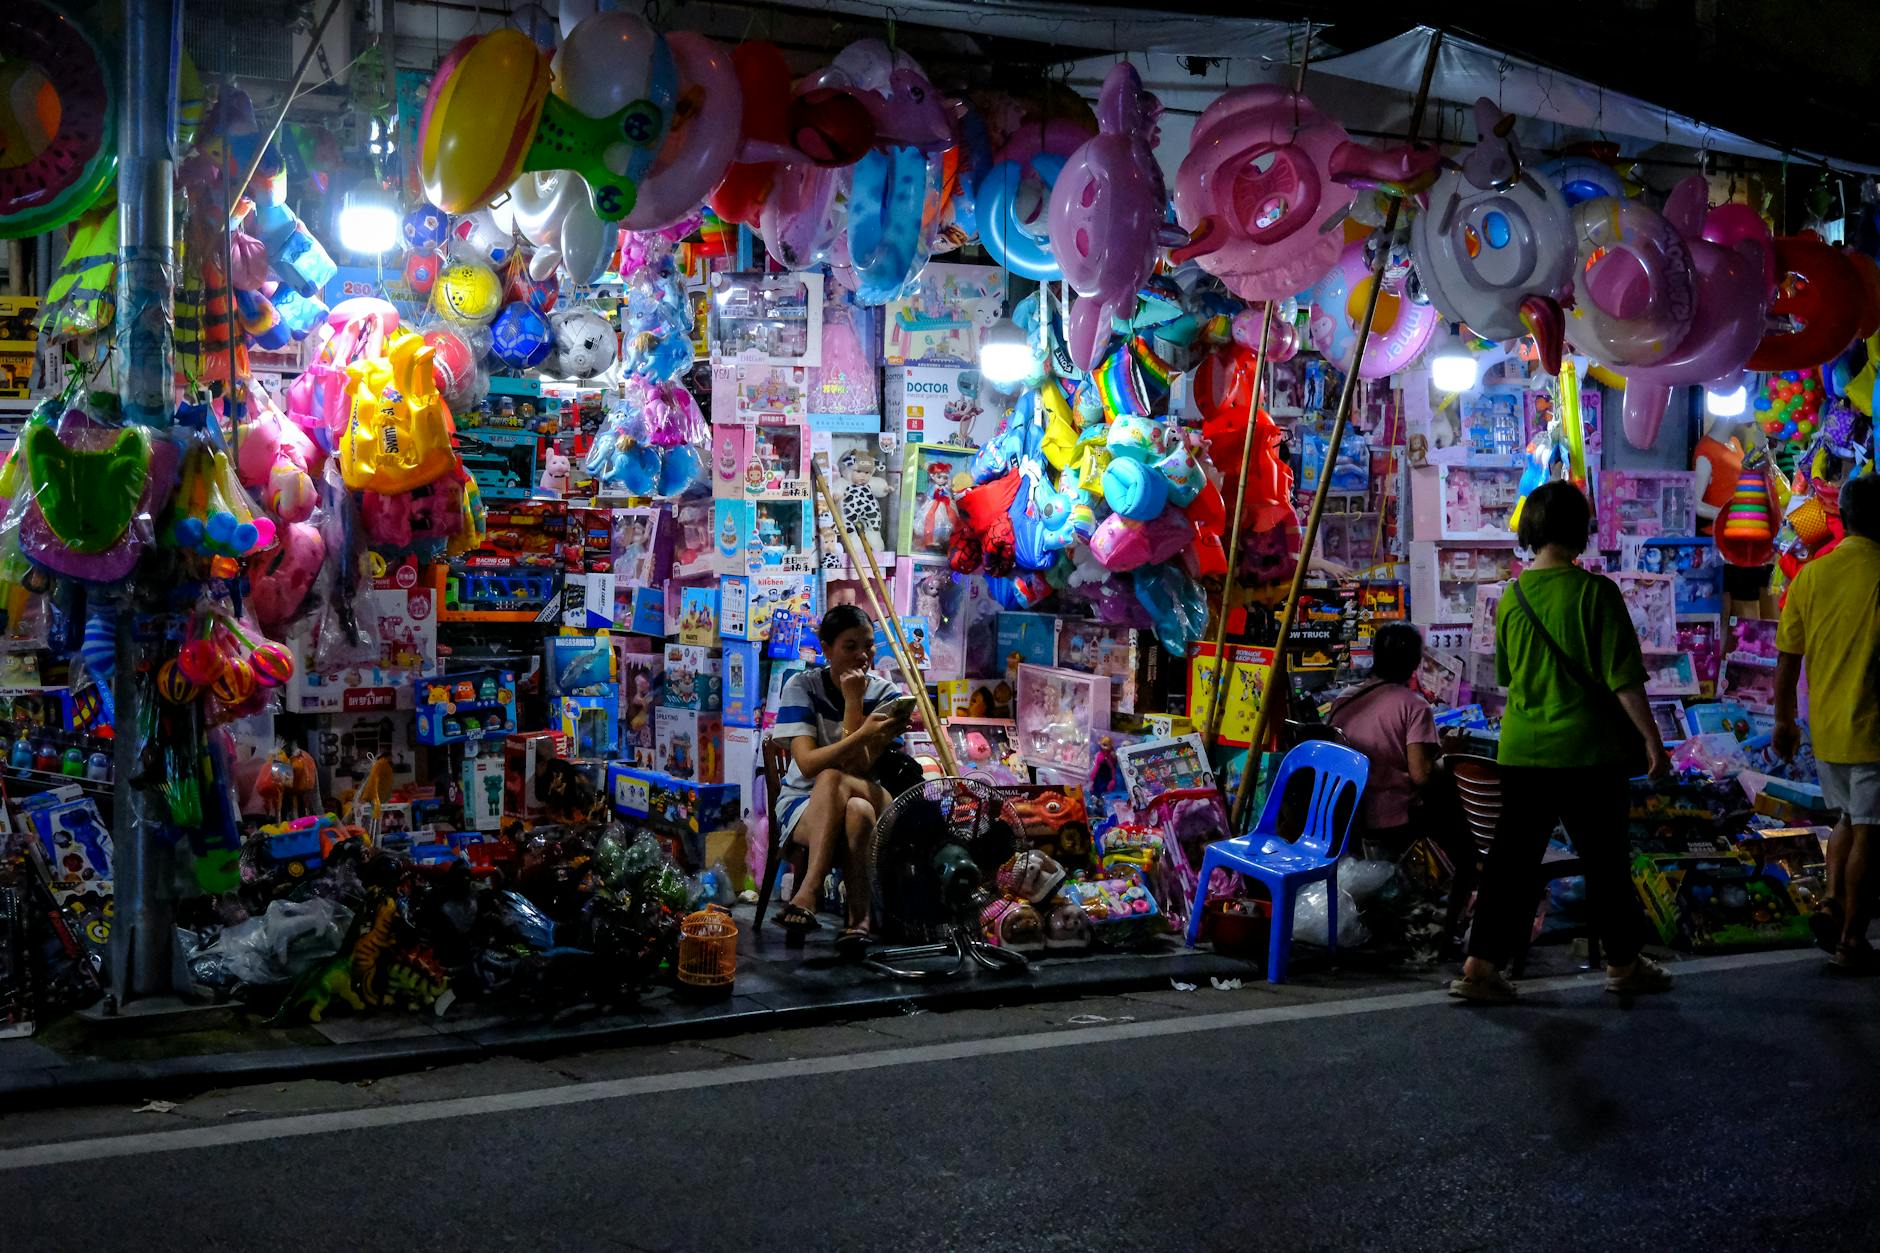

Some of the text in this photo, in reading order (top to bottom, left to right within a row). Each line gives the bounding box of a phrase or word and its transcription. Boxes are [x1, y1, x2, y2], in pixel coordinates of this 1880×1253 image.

[906, 382, 949, 394] DOCTOR
[383, 426, 400, 454] Swim
[475, 556, 497, 564] RACING
[757, 578, 785, 586] kitchen
[1302, 631, 1331, 639] TRUCK
[555, 736, 568, 756] TRY
